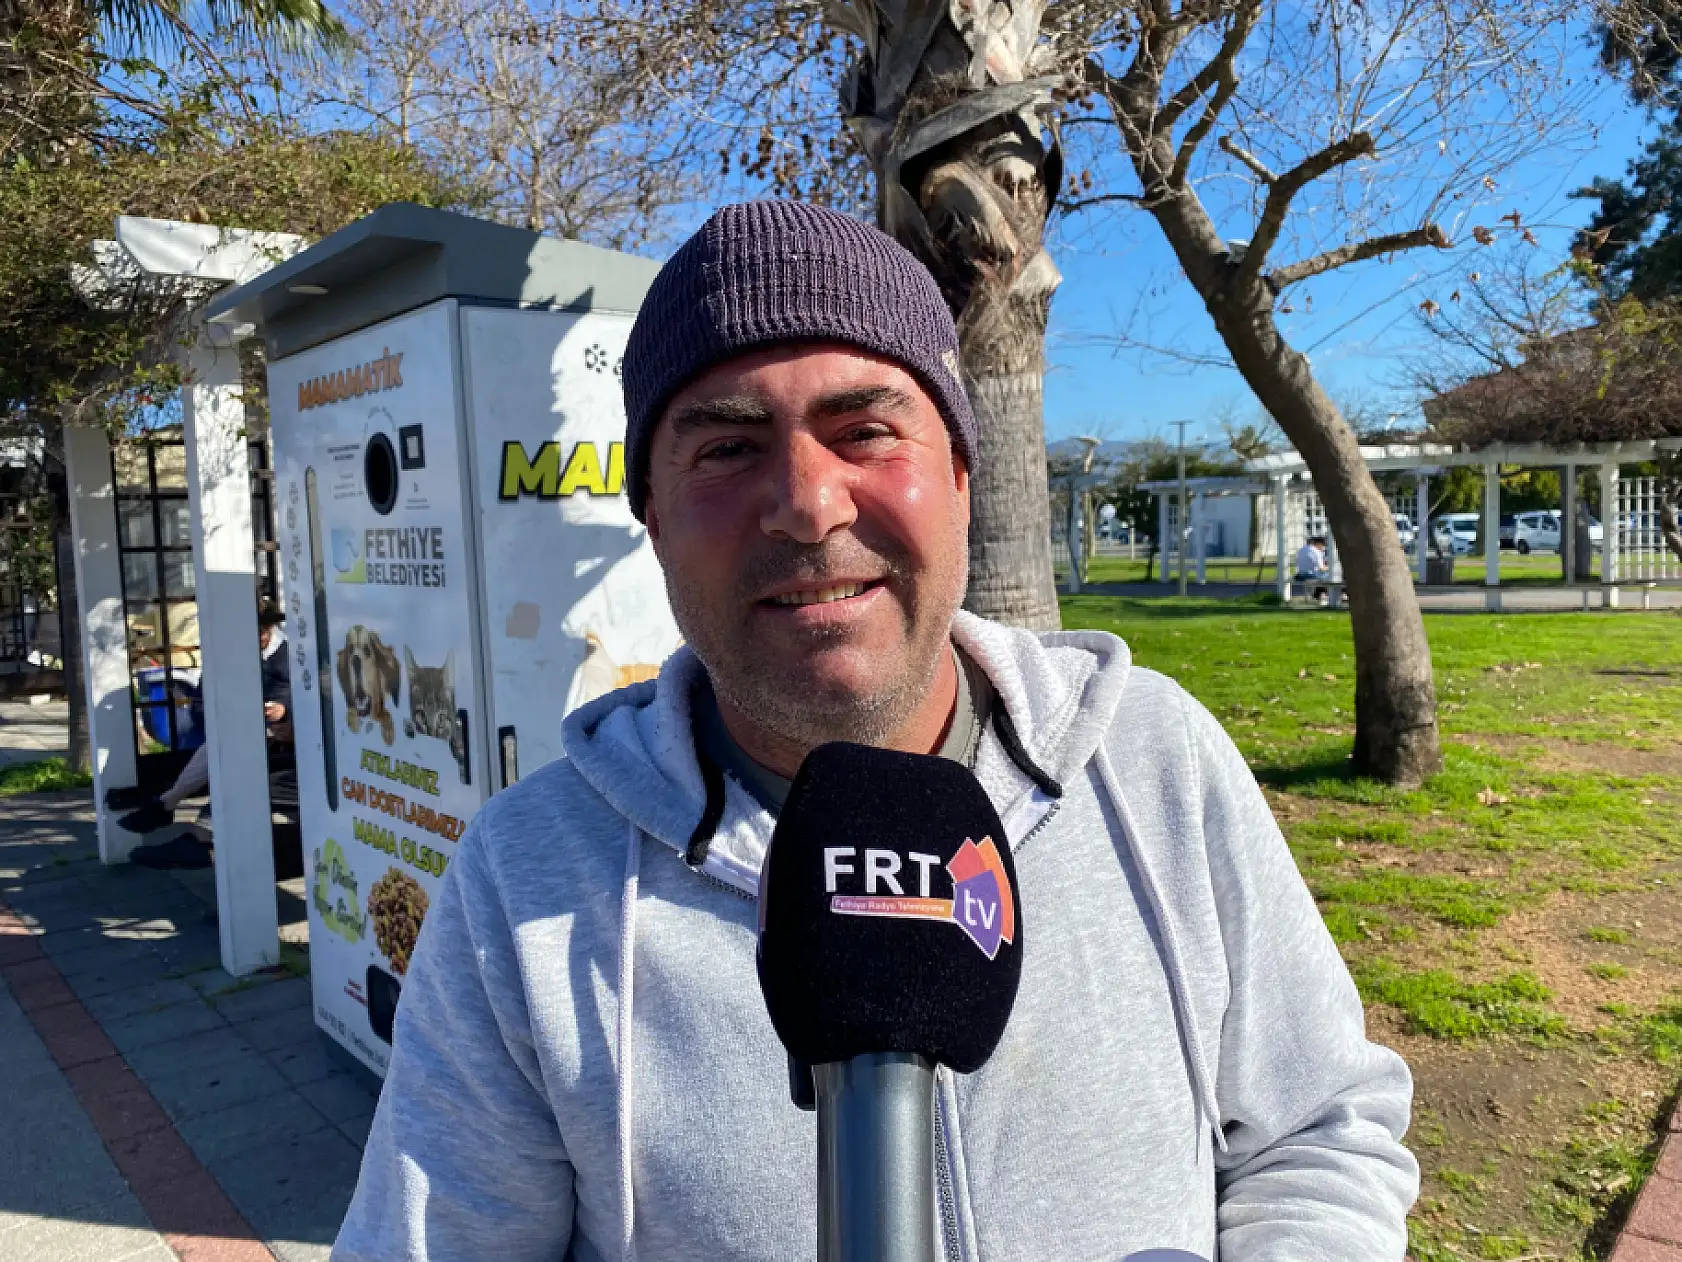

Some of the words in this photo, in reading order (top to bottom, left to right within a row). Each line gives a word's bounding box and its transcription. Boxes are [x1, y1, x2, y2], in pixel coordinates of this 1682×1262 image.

[297, 346, 404, 412] MAMAMATİK
[342, 775, 366, 807] CAN
[353, 815, 400, 860] MAMA
[400, 836, 451, 878] OLSU
[823, 847, 941, 898] FRT
[963, 888, 997, 930] tv
